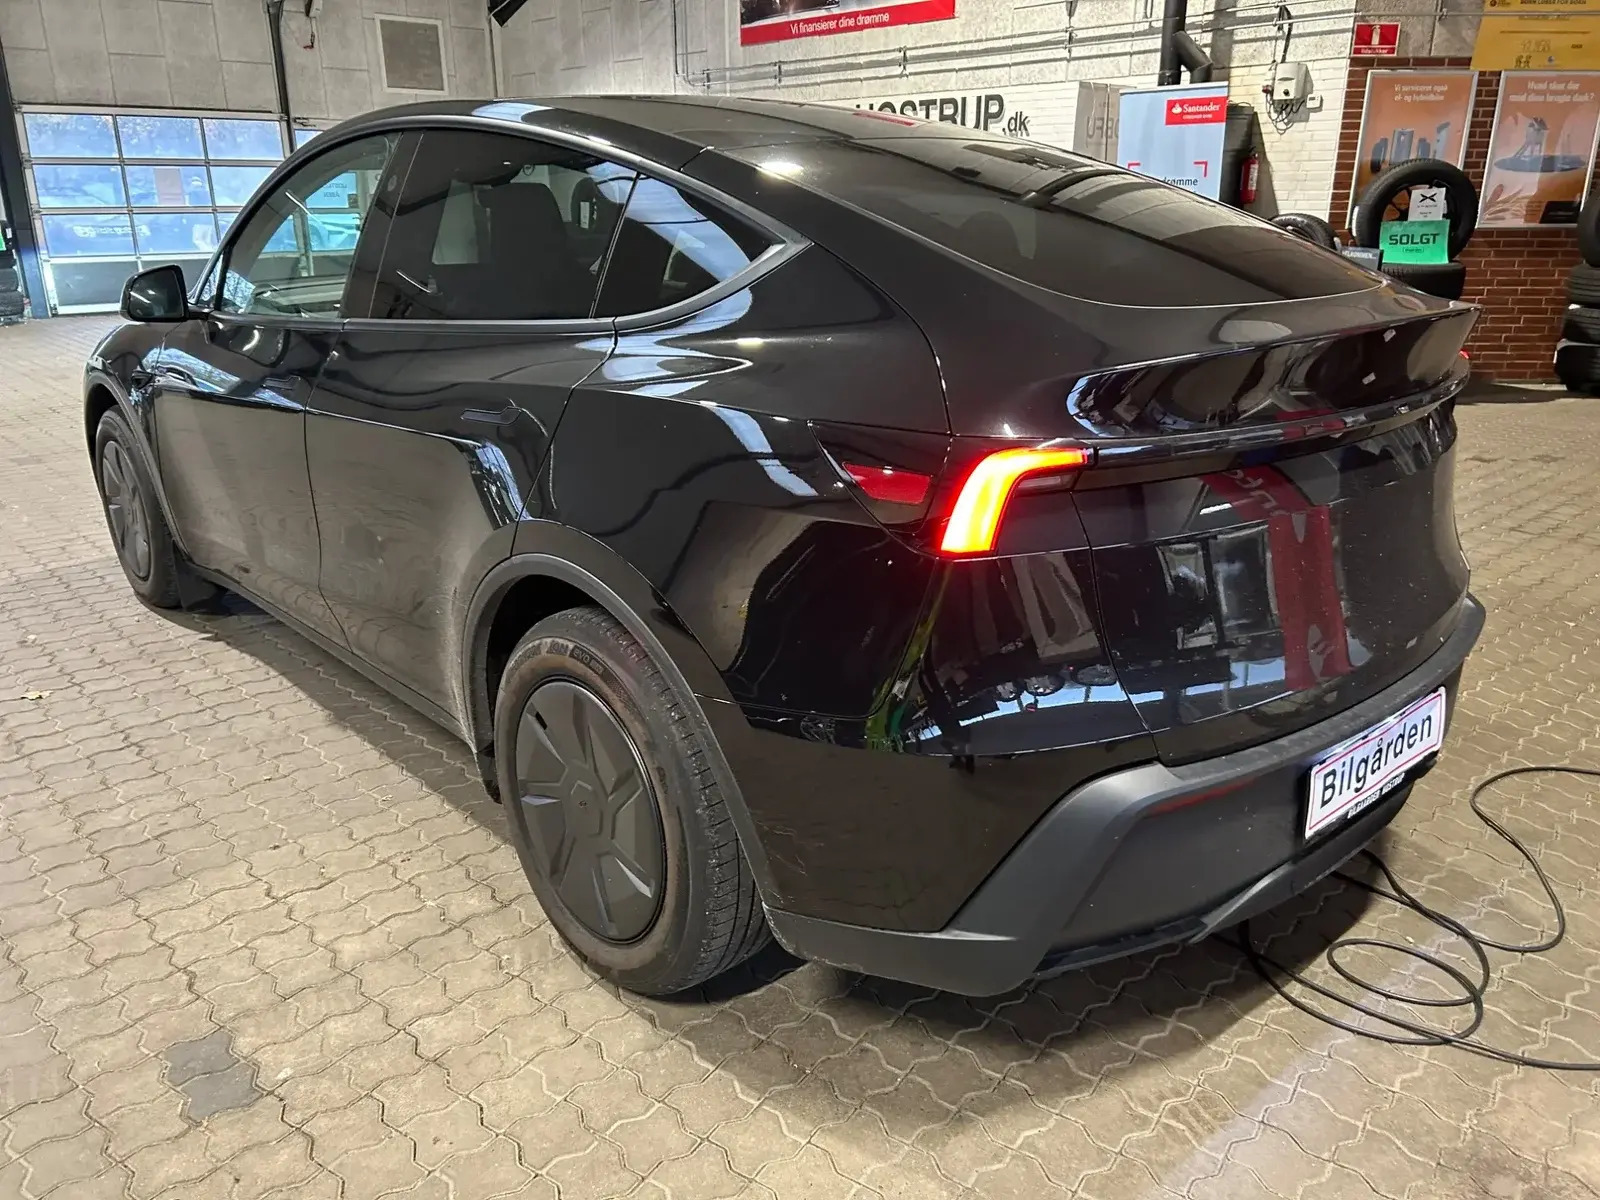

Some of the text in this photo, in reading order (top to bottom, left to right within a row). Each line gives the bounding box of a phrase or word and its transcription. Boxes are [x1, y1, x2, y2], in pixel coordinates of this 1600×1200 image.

[790, 12, 889, 34] Vi finansierer dine drømme
[1182, 101, 1221, 113] Santander
[1388, 233, 1440, 246] SOLGT
[1320, 714, 1432, 809] Bilgården
